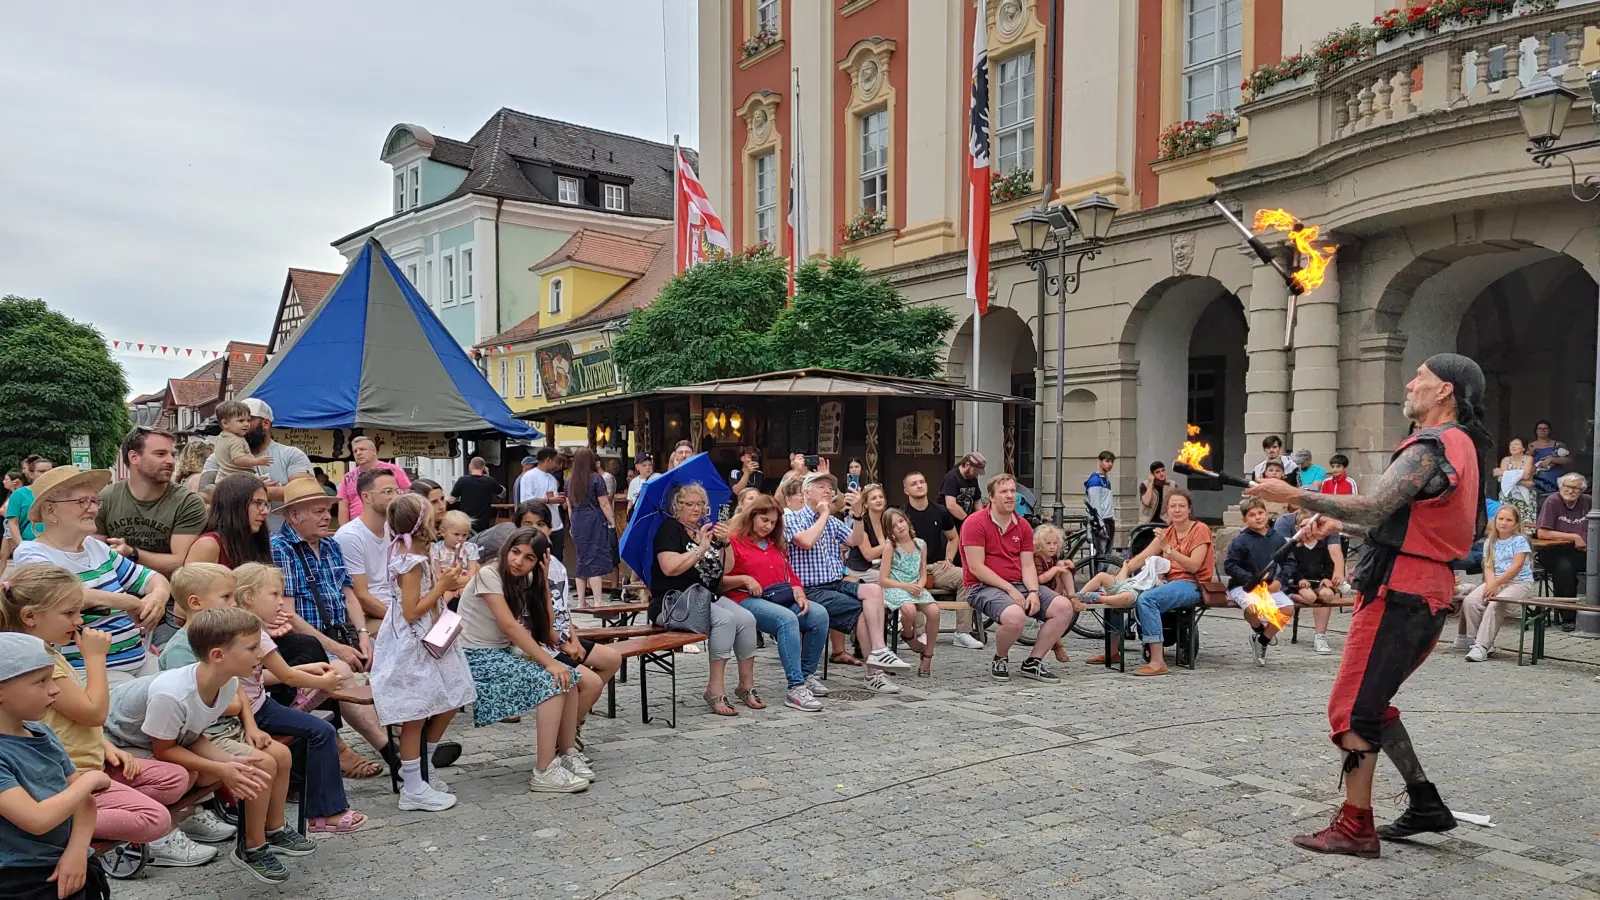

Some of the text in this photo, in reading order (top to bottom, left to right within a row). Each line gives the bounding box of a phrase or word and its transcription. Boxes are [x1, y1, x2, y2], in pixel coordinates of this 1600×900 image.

[572, 358, 614, 392] TAVERNE
[120, 526, 156, 538] Denim
[144, 538, 168, 547] BLUE
